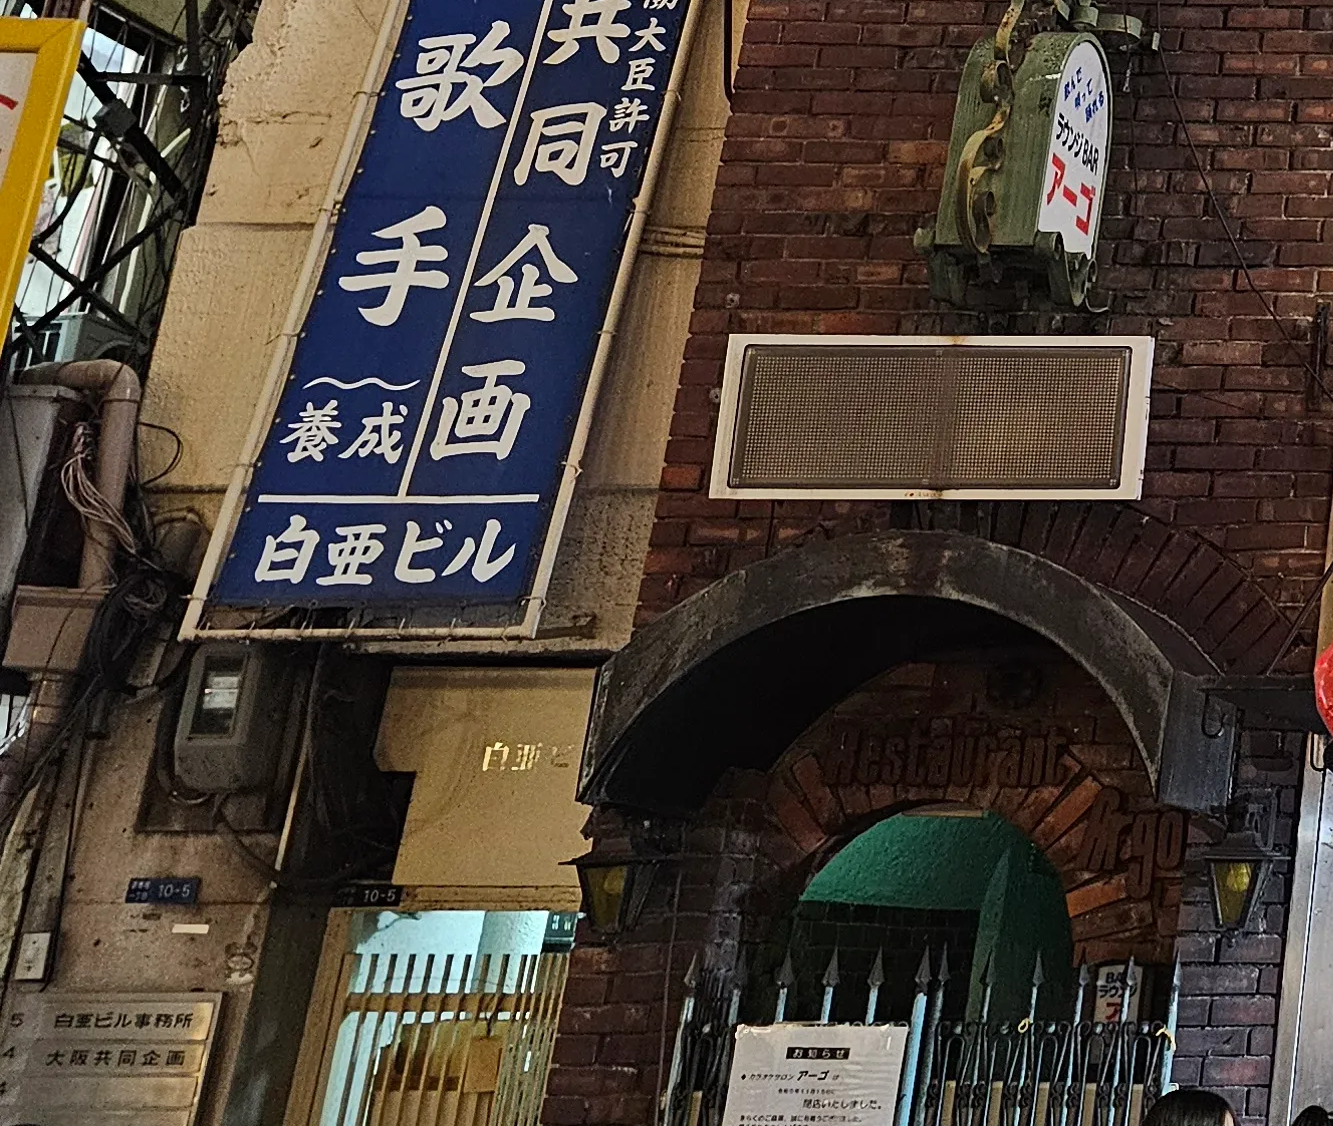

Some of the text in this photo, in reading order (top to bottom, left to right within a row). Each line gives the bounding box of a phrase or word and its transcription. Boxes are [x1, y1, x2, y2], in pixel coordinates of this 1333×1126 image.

[1056, 112, 1100, 176] ラウンジBAR
[337, 20, 525, 327] 歌手
[1046, 153, 1096, 236] アーゴ
[279, 398, 409, 465] 養成
[253, 514, 517, 586] 白亜ビル
[158, 883, 191, 898] 10-5
[364, 888, 397, 903] 10-5
[10, 1012, 194, 1030] 5 白亜ビル事務所
[3, 1045, 186, 1067] 4 大阪共同企画
[792, 1048, 846, 1059] お知らせ
[797, 1070, 830, 1082] アーゴ
